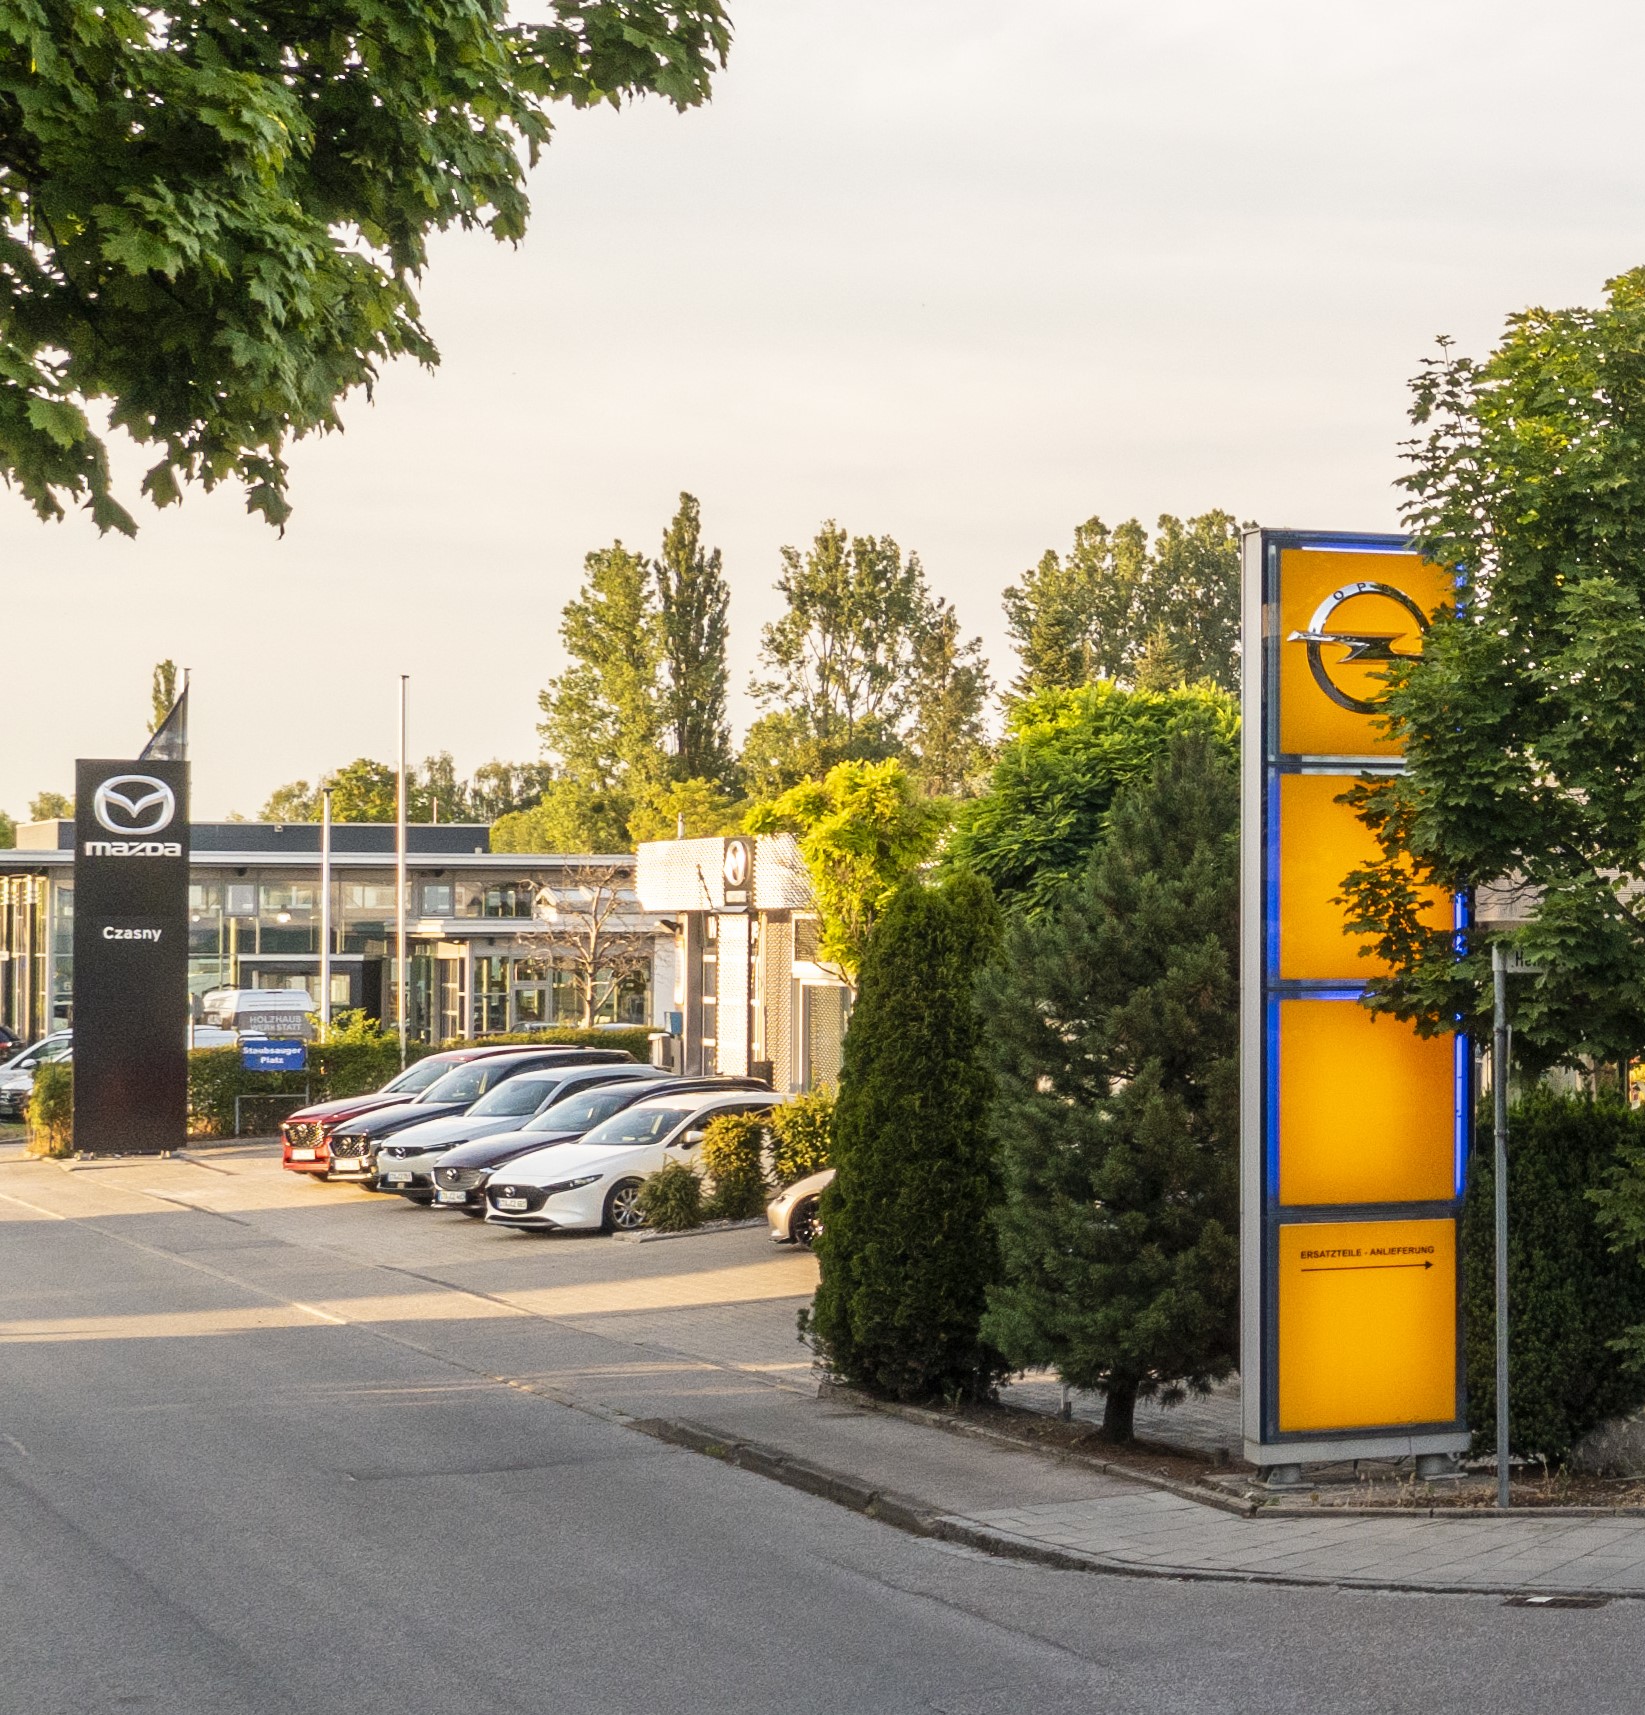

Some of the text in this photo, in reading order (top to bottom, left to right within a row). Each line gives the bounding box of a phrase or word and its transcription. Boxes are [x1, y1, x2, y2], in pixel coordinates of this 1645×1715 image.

[85, 841, 182, 857] mazda
[103, 926, 162, 942] Czasny
[249, 1015, 302, 1024] HOLZHAUS
[243, 1047, 302, 1056] Staubsauger
[261, 1056, 284, 1064] Platz
[1300, 1248, 1362, 1259] ERSATZTEILE
[1369, 1245, 1435, 1256] ANLIEFERUNG
